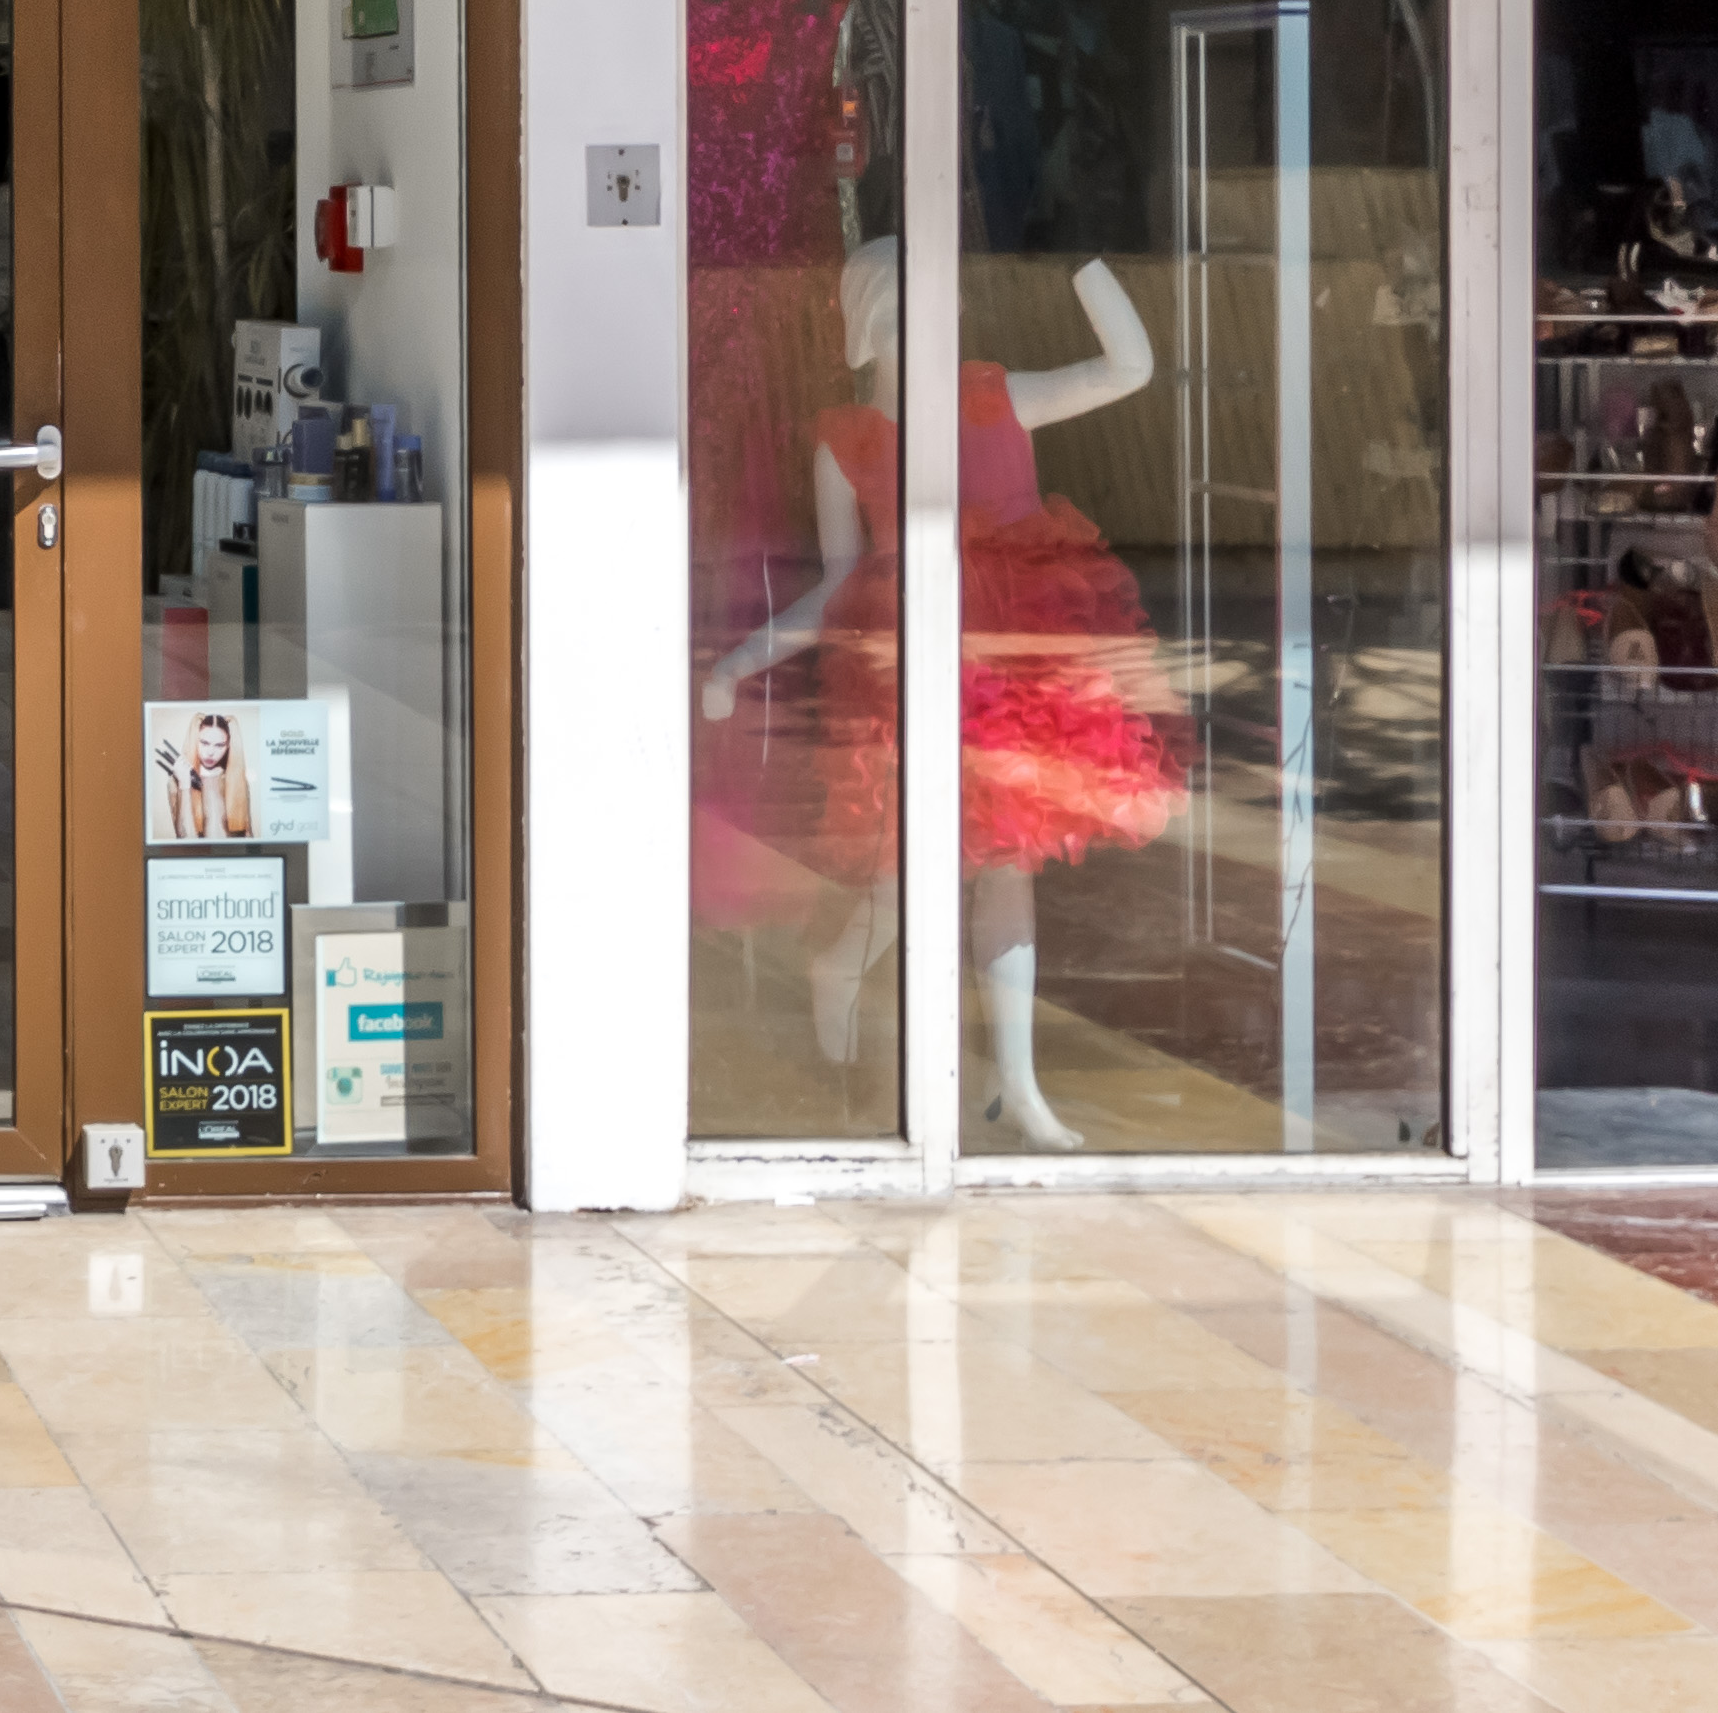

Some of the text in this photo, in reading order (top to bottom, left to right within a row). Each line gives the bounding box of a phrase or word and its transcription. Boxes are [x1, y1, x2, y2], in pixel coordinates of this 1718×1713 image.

[270, 819, 295, 836] ghd
[157, 891, 275, 920] smartbond
[157, 931, 206, 942] SALON
[211, 930, 274, 954] 2018
[157, 944, 205, 954] EXPERT
[159, 1087, 208, 1099] SALON
[212, 1084, 277, 1111] 2018
[159, 1099, 208, 1112] EXPERT
